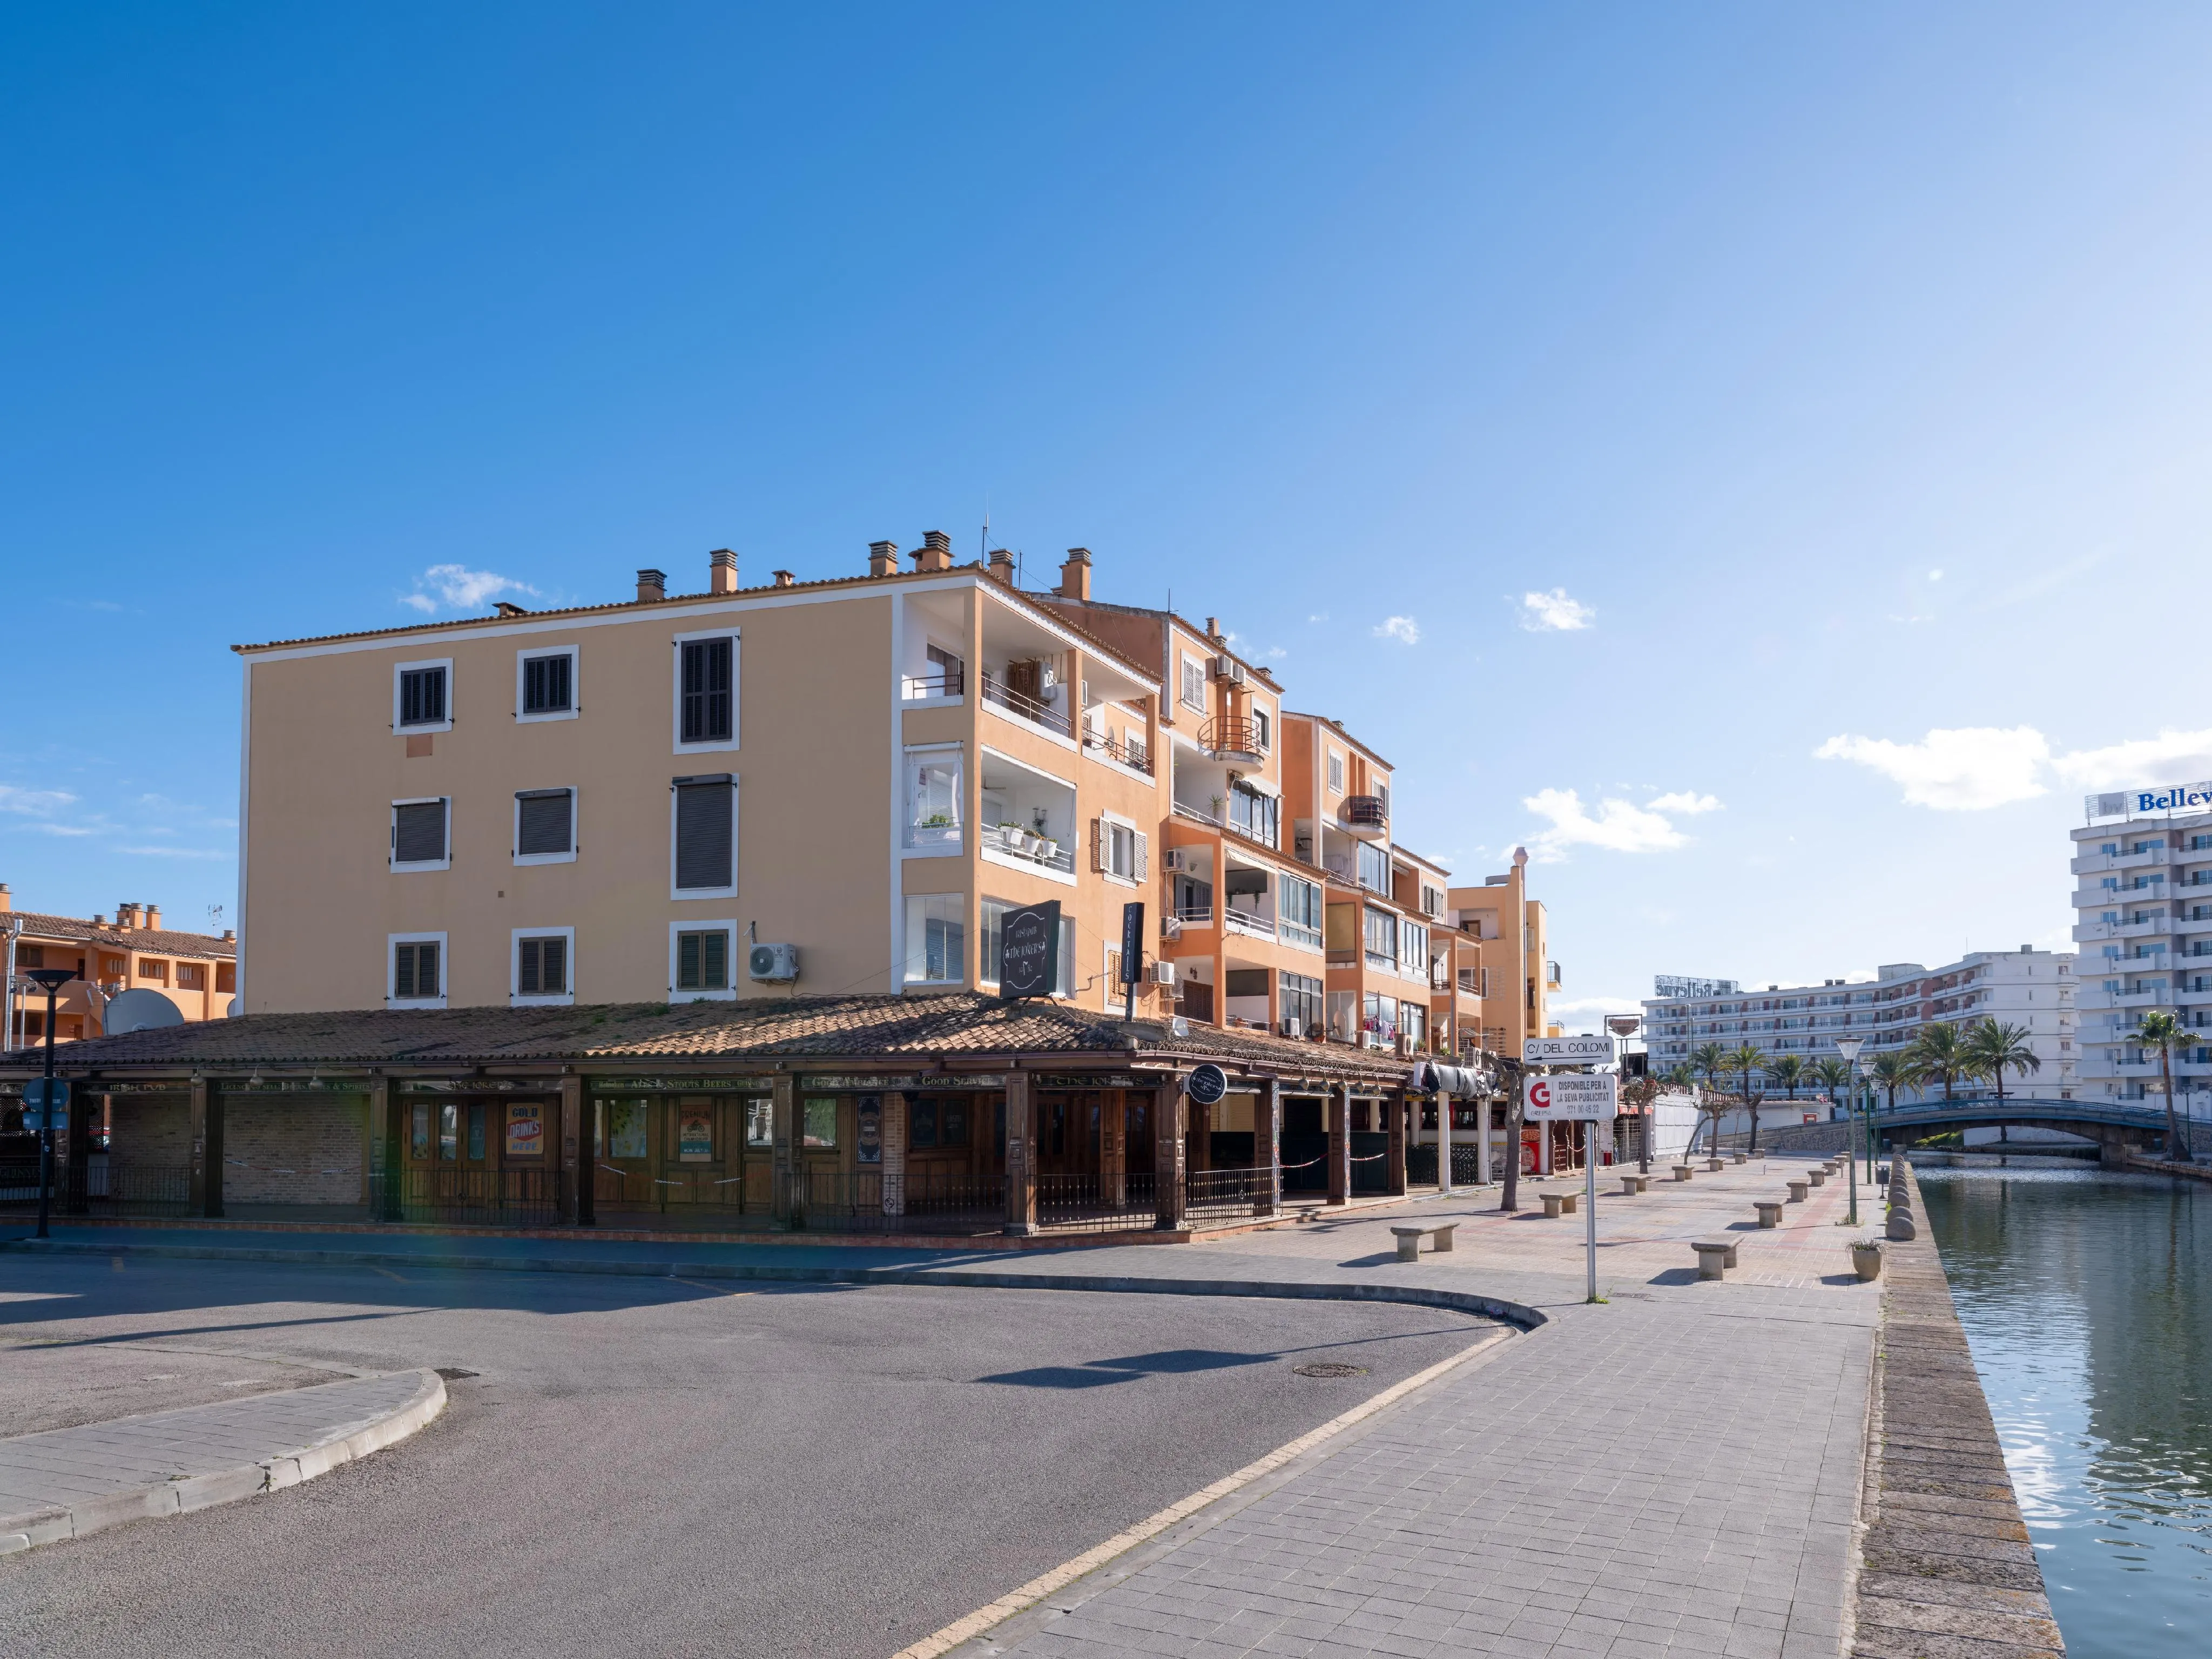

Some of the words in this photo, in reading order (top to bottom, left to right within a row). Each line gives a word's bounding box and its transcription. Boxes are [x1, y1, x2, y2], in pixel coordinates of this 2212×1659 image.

[1527, 1044, 1539, 1054] C/
[1544, 1044, 1564, 1053] DEL
[1568, 1043, 1609, 1053] COLOMI
[703, 1079, 731, 1088] BEERS
[921, 1076, 950, 1085] GOOD
[953, 1076, 993, 1086] SERVICE
[1559, 1081, 1590, 1090] DISPONIBLE
[1591, 1081, 1601, 1090] PER
[1602, 1081, 1607, 1090] A
[1557, 1094, 1563, 1103] LA
[1564, 1093, 1577, 1102] SEVA
[1579, 1092, 1609, 1102] PUBLICITAT
[512, 1106, 538, 1117] COLD
[1592, 1104, 1600, 1114] 22
[510, 1120, 539, 1138] DRINKS
[511, 1142, 537, 1150] HERE
